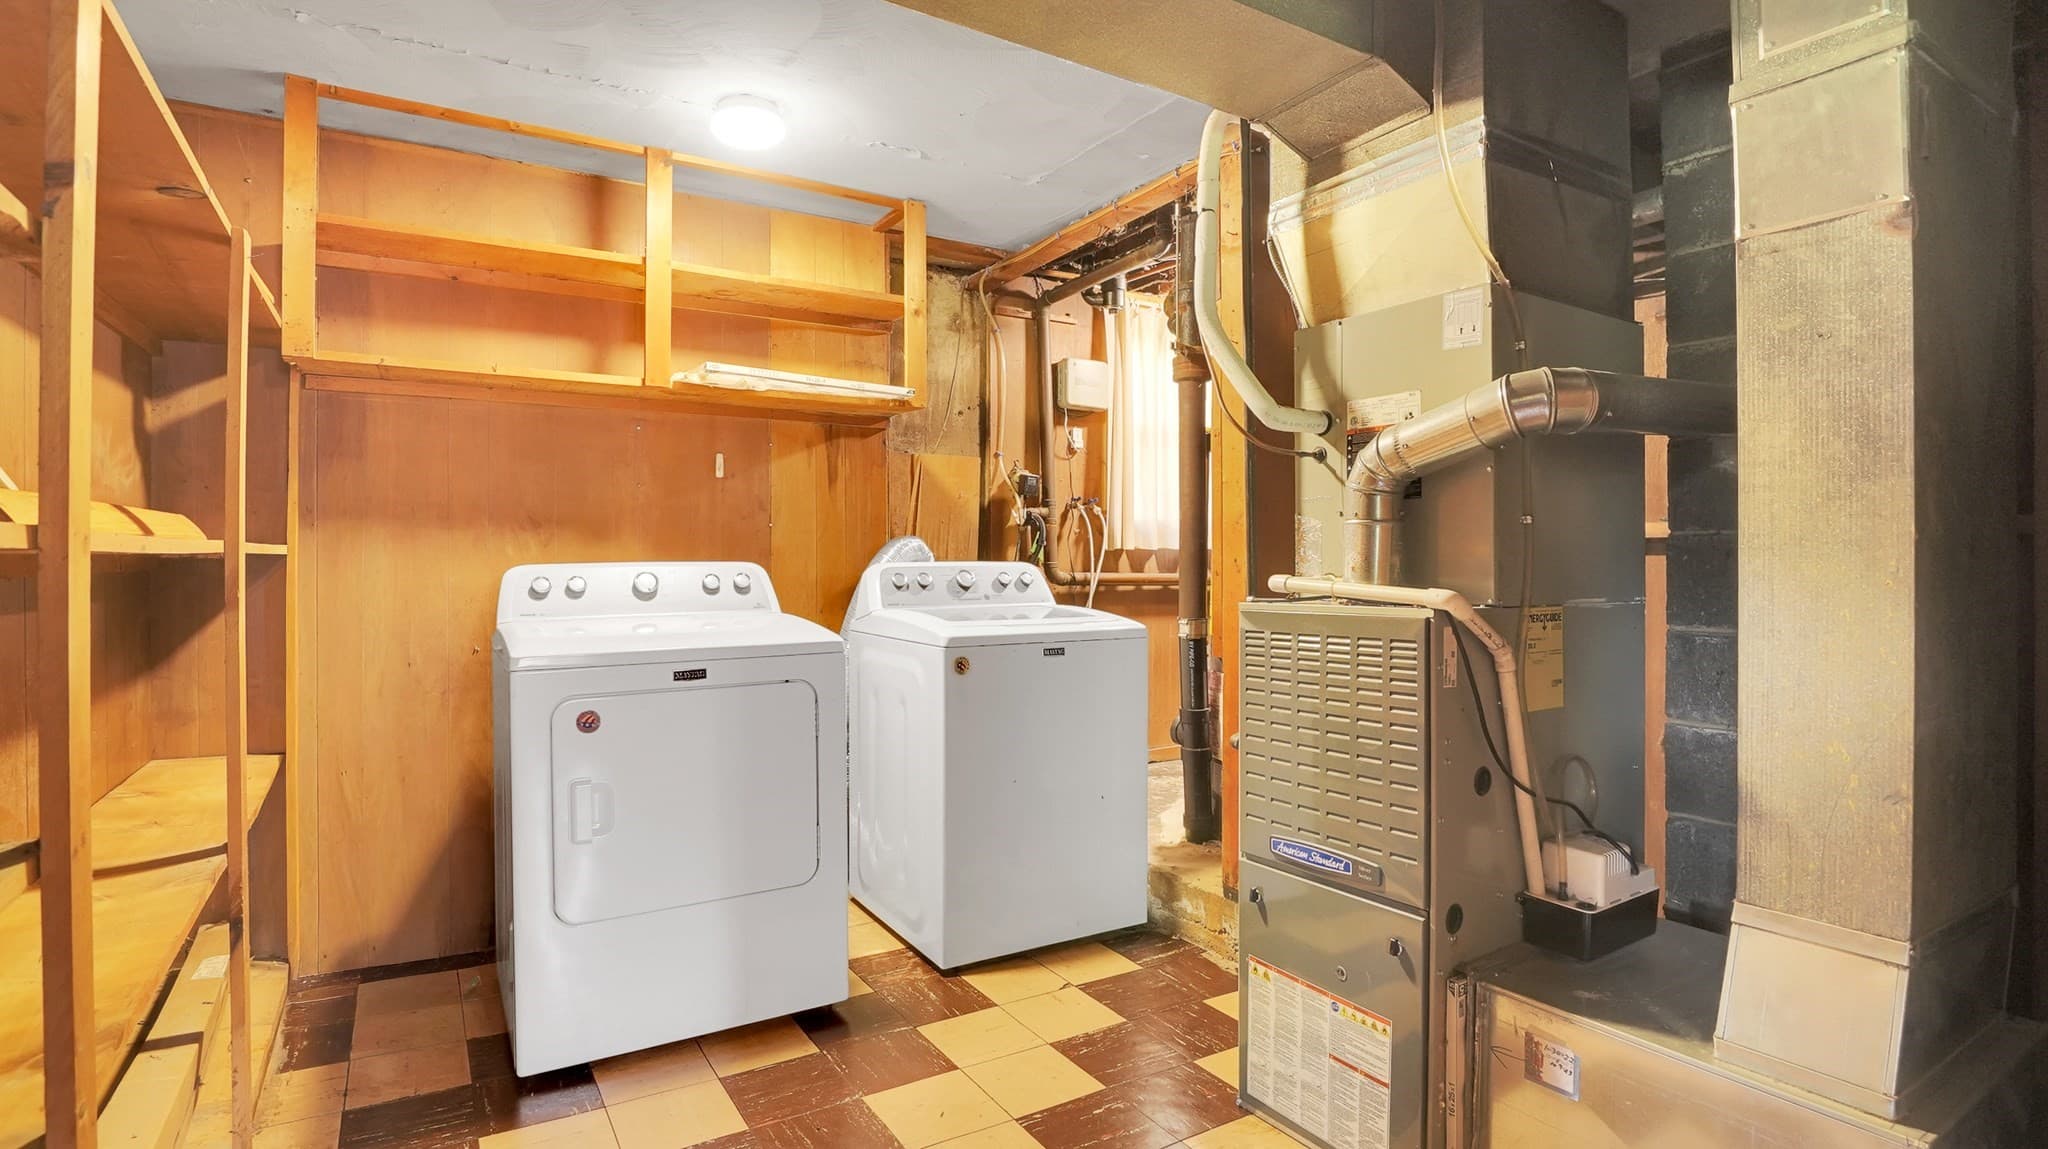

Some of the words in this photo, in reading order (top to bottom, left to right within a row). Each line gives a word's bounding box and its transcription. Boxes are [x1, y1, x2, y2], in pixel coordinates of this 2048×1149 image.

[1528, 612, 1562, 624] NERGYGUIDE
[1276, 842, 1308, 860] American
[1308, 851, 1345, 871] Standard
[1448, 1081, 1456, 1118] 16x25x1
